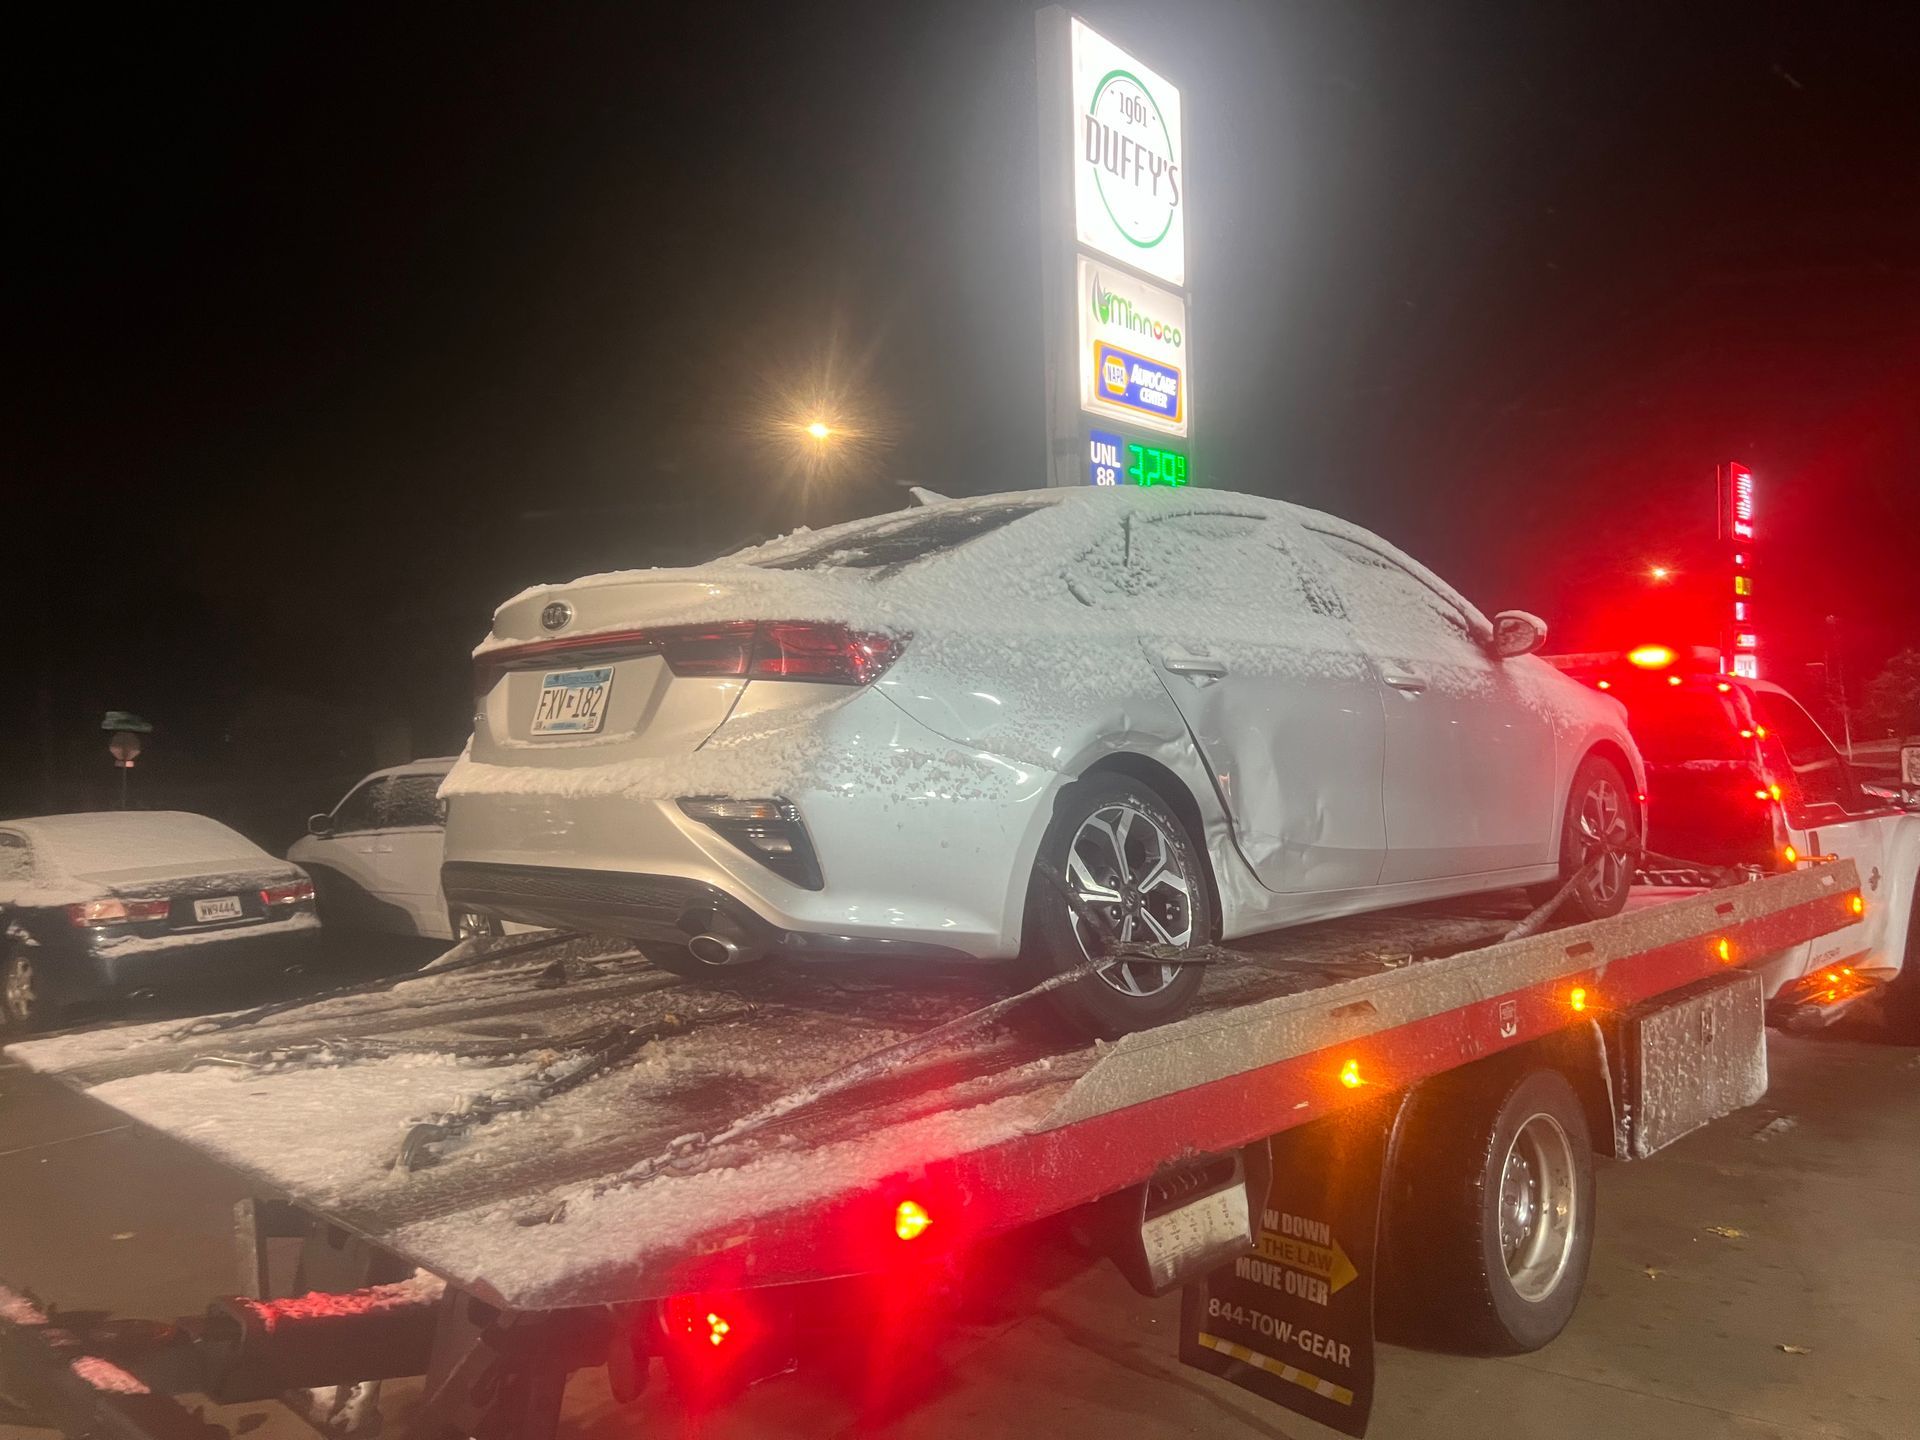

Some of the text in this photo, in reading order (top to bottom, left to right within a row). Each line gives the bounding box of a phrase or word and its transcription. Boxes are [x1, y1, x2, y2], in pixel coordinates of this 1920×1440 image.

[1119, 91, 1147, 128] 1961
[1085, 114, 1179, 207] DUFFY'S
[1106, 363, 1125, 386] NAPA
[1140, 387, 1168, 409] CENTER
[1090, 440, 1121, 468] UNL
[1096, 466, 1116, 486] 88
[1281, 1213, 1330, 1246] DOWN
[1262, 1237, 1335, 1272] THE LAW
[1236, 1256, 1328, 1307] MOVE OVER
[1208, 1297, 1351, 1368] 844-TOW-GEAR
